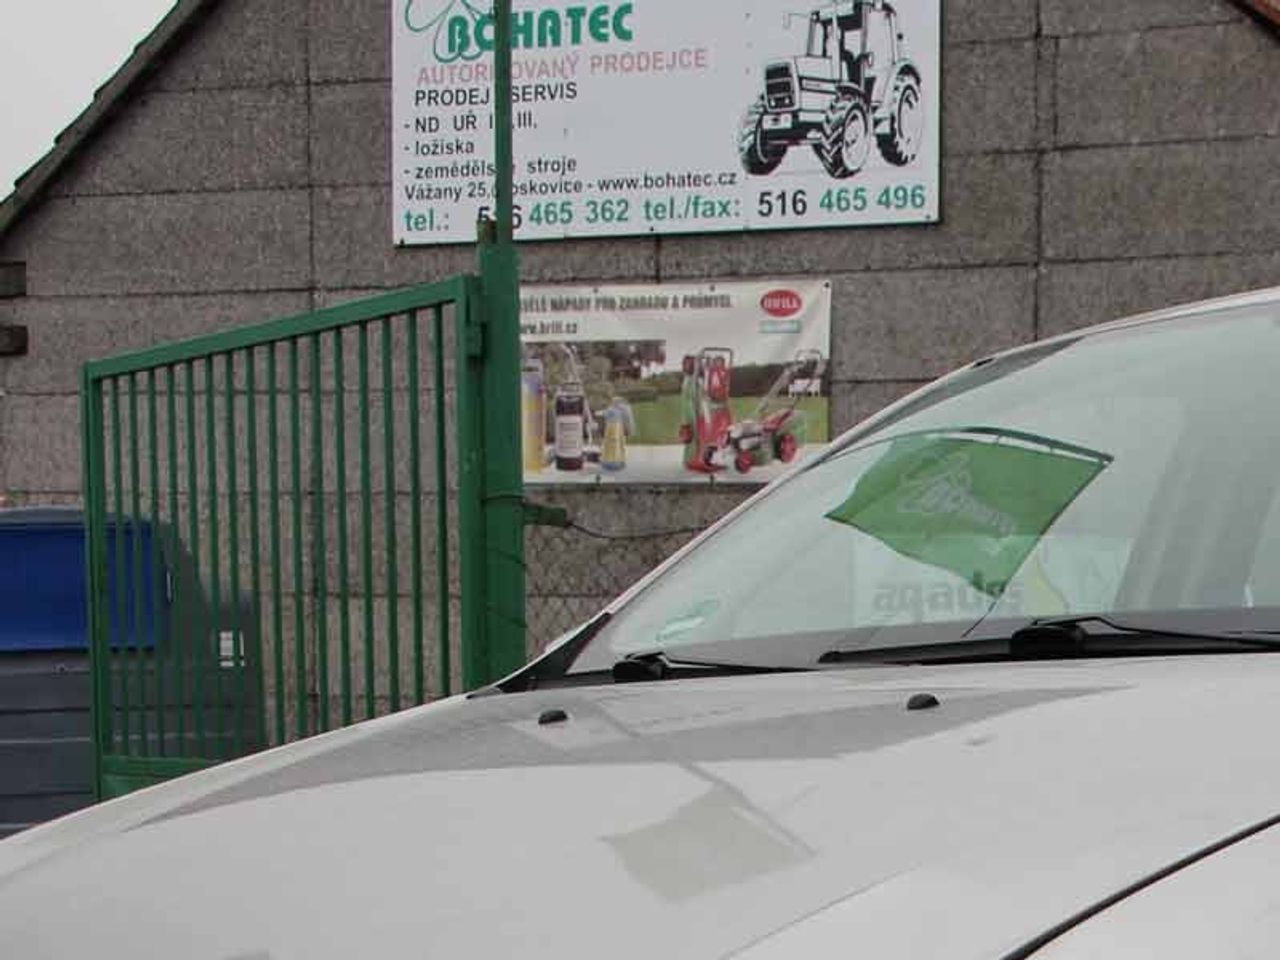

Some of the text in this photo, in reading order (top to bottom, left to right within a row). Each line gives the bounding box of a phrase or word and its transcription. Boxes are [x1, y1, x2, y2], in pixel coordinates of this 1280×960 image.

[448, 2, 633, 54] BOHATEC
[417, 48, 708, 86] AUTORIOVANÝ PRODEJCE
[414, 82, 577, 106] PRODEJ SERVIS
[414, 117, 440, 133] ND
[453, 110, 477, 131] UŘ
[415, 141, 474, 156] ložiska
[526, 157, 577, 176] stroje
[404, 180, 462, 202] Vážany
[598, 173, 737, 191] www.bohatec.cz
[404, 185, 926, 231] tel.: 56 465 362 tel./fax: 516 465 496
